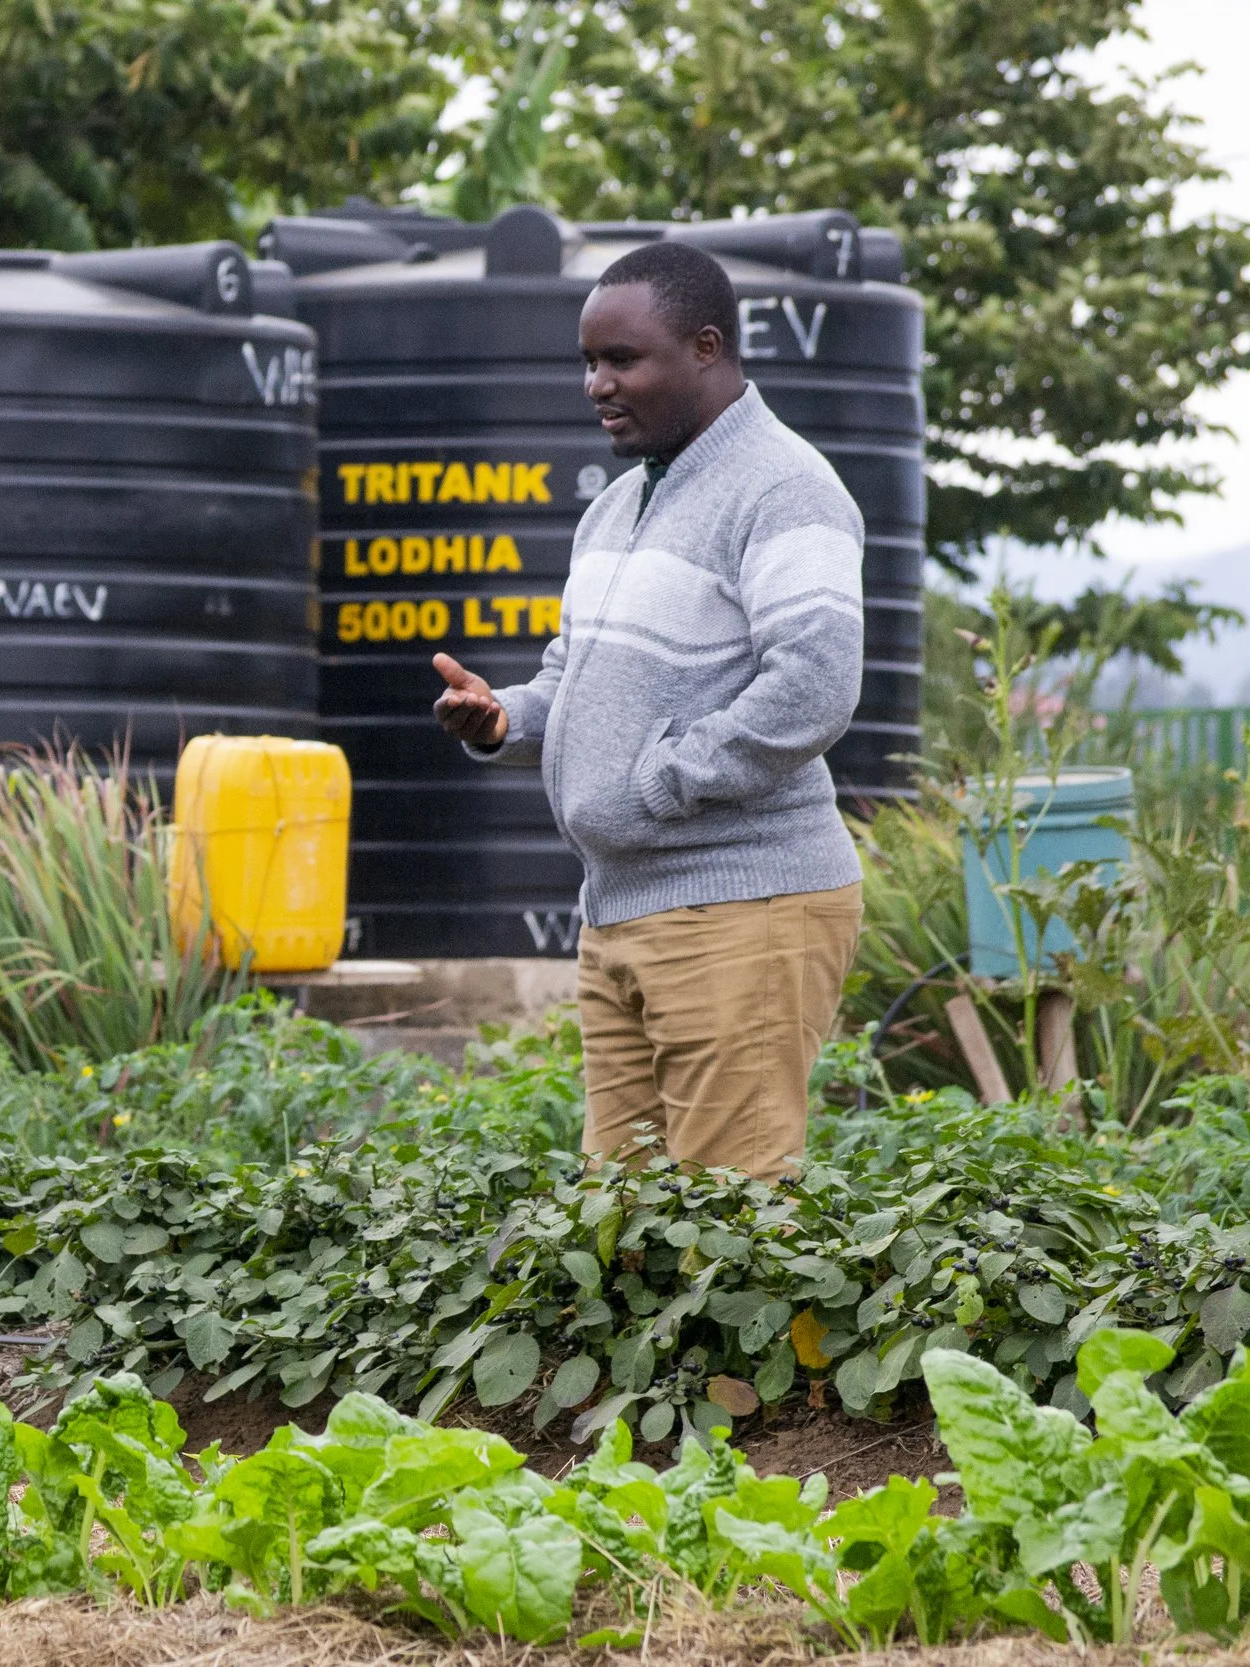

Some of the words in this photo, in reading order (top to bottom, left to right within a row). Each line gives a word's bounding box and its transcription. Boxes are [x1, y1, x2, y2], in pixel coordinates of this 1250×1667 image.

[826, 229, 853, 277] 7
[217, 256, 240, 302] 6
[738, 296, 827, 359] EV
[338, 462, 553, 505] TRITANK
[344, 534, 523, 576] LODHIA
[337, 600, 450, 643] 5000
